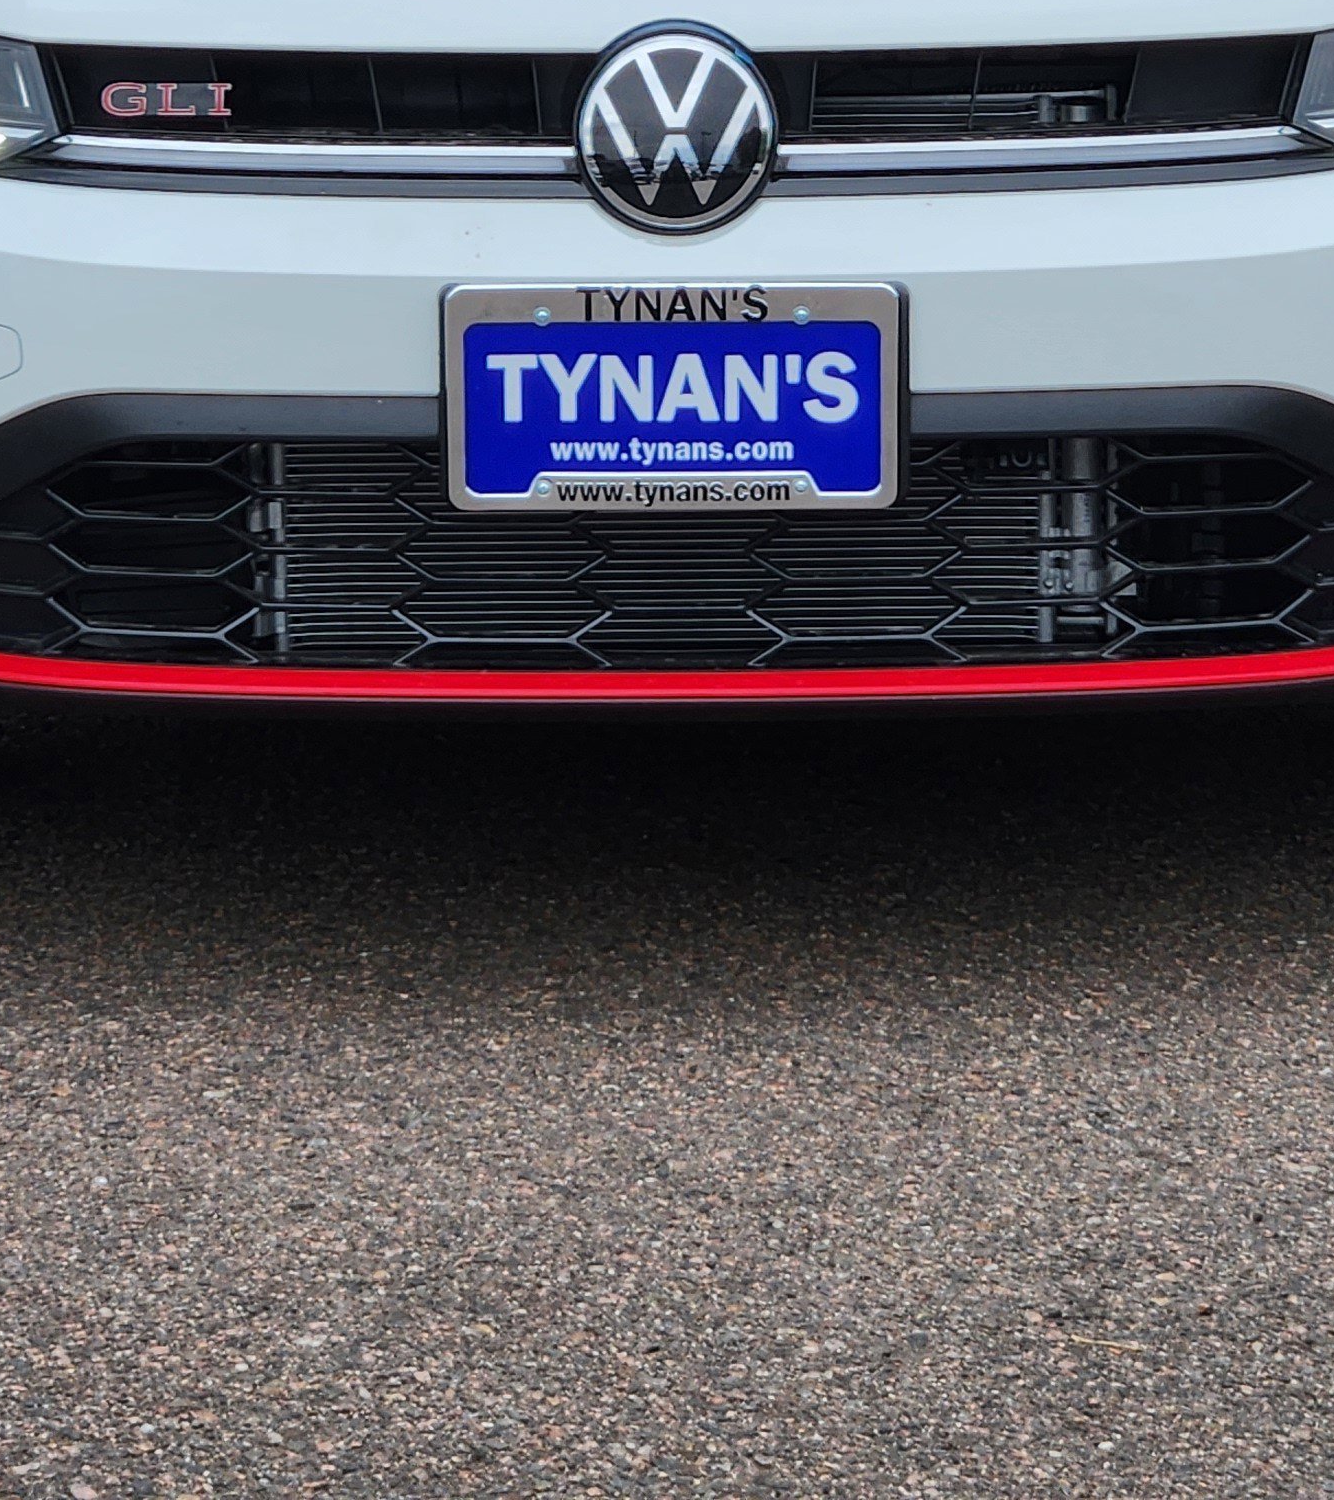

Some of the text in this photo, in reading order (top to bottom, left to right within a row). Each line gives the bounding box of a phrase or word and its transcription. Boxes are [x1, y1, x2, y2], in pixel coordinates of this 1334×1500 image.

[100, 82, 233, 117] GLI
[575, 284, 769, 323] TYNAN'S
[486, 350, 860, 424] TYNAN'S
[548, 436, 796, 467] www.tynans.com
[556, 477, 791, 507] www.tynans.com
